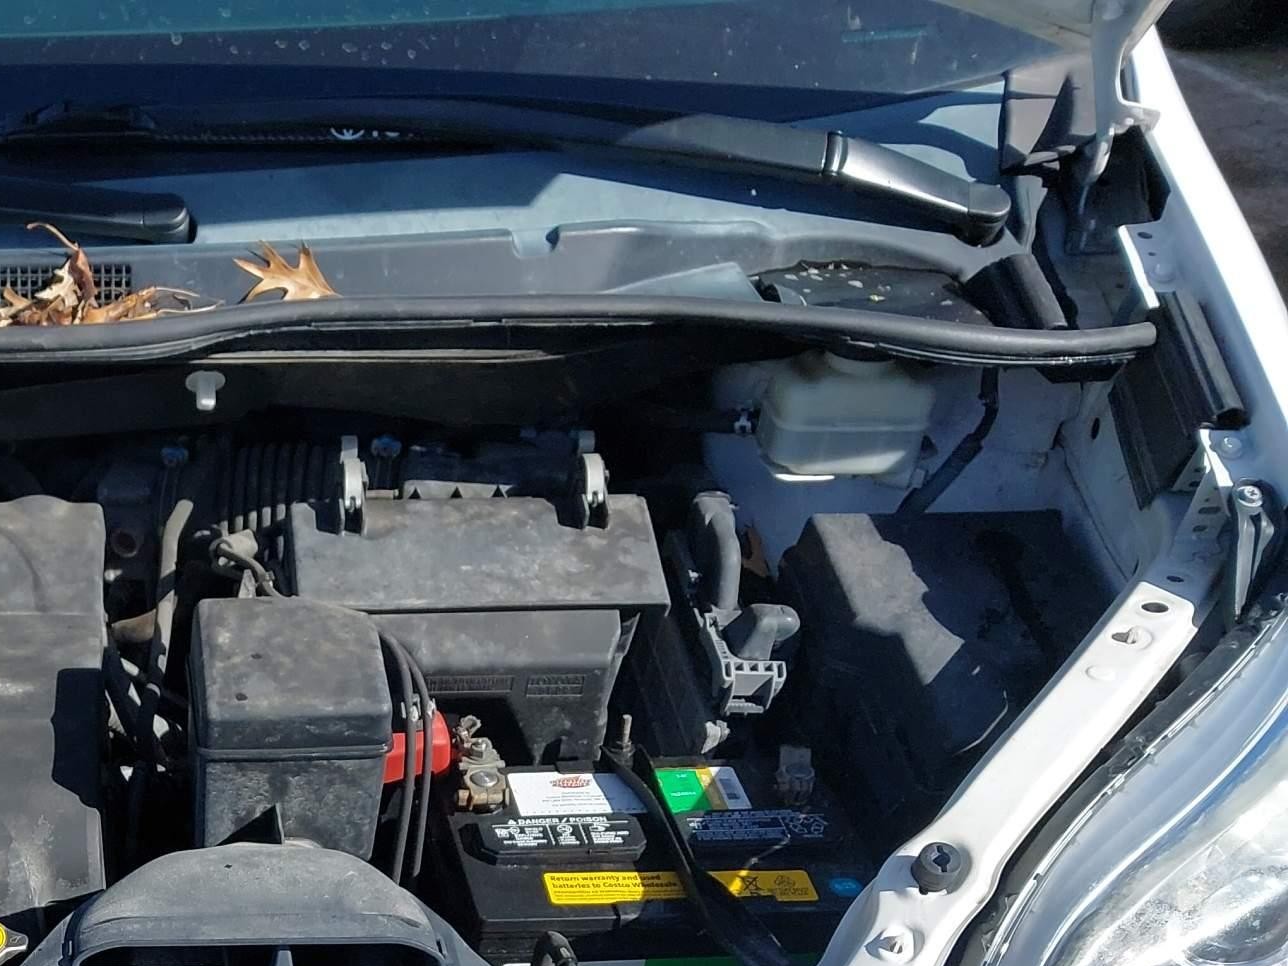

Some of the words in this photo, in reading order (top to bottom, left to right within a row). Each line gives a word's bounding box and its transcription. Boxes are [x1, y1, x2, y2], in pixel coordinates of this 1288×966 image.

[518, 817, 560, 825] DANGER
[581, 875, 620, 883] warranty
[552, 881, 591, 889] batteries
